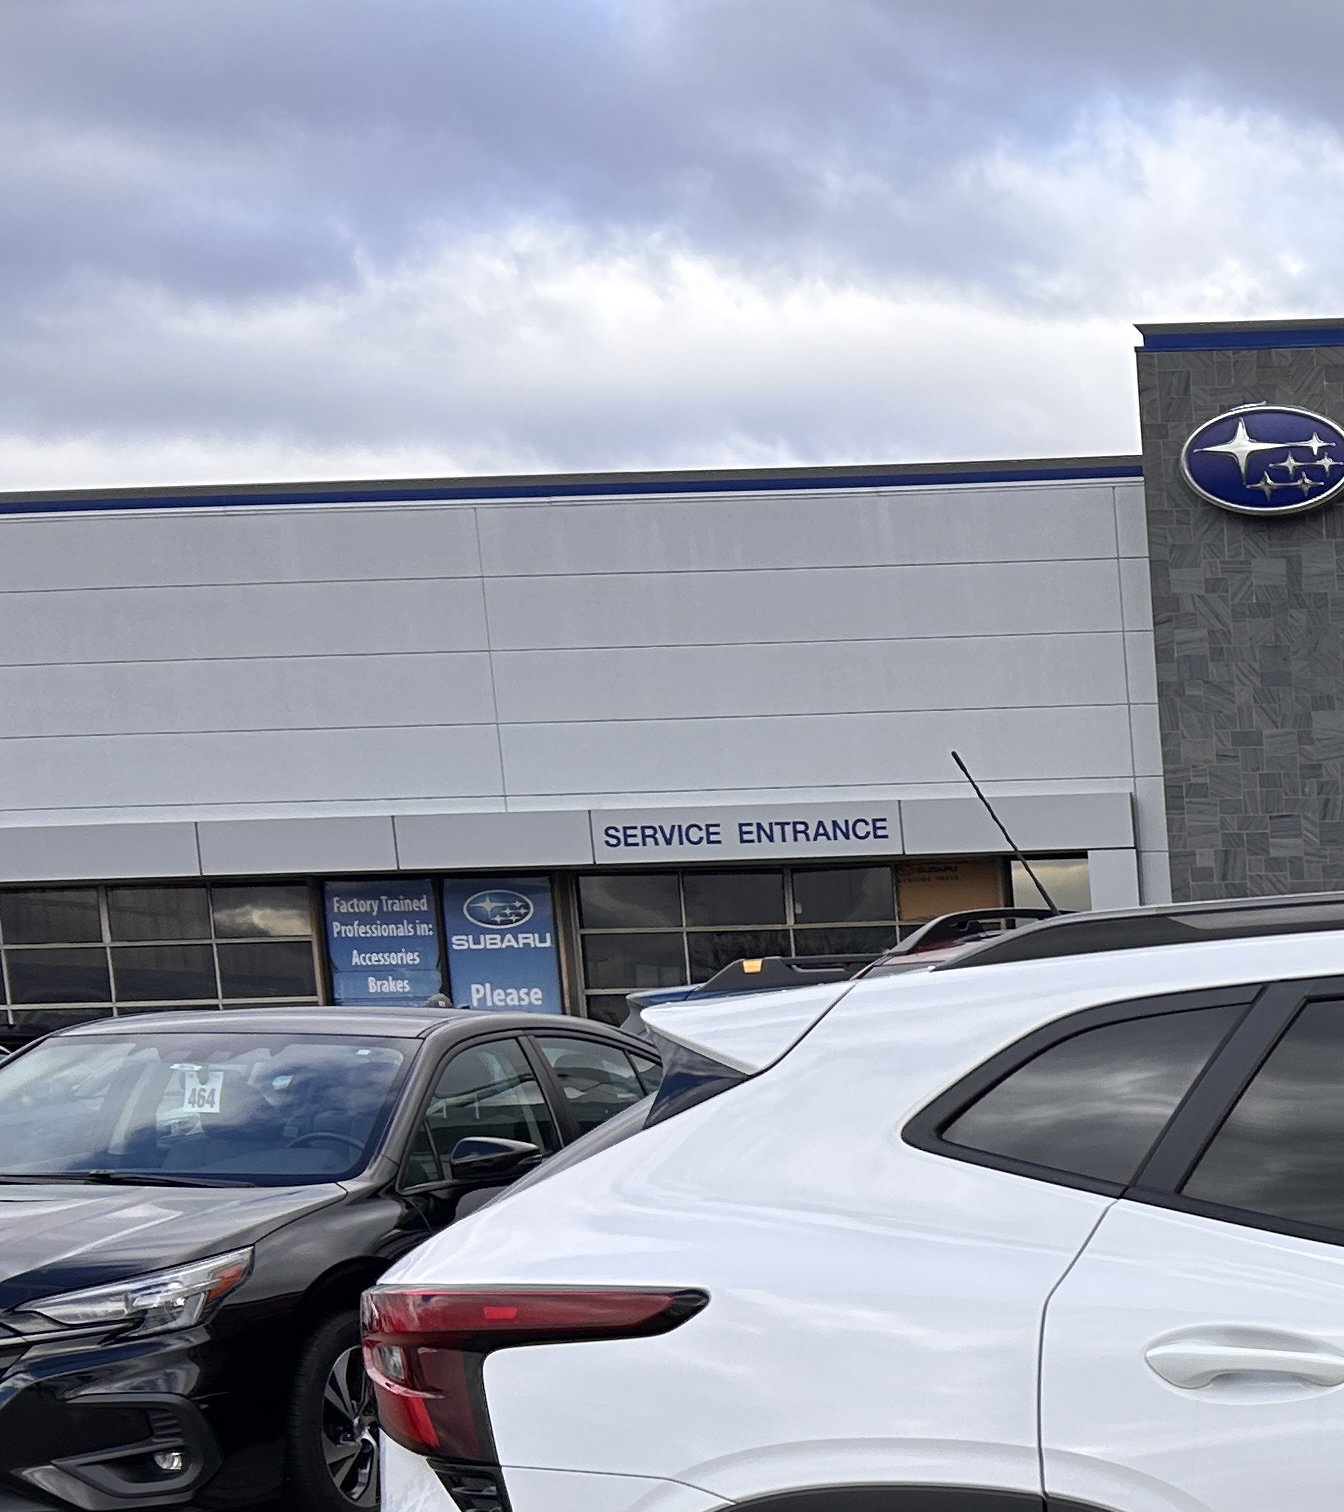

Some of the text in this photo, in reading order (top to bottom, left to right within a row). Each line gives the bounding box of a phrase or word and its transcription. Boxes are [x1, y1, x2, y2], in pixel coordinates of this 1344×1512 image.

[604, 818, 889, 847] SERVICE ENTRANCE
[333, 895, 428, 916] Factory Trained
[333, 921, 434, 938] Professionals in:
[452, 933, 552, 950] SUBARU
[351, 948, 421, 966] Accessories
[368, 976, 411, 993] Brakes
[471, 983, 543, 1007] Please
[187, 1087, 216, 1109] 464
